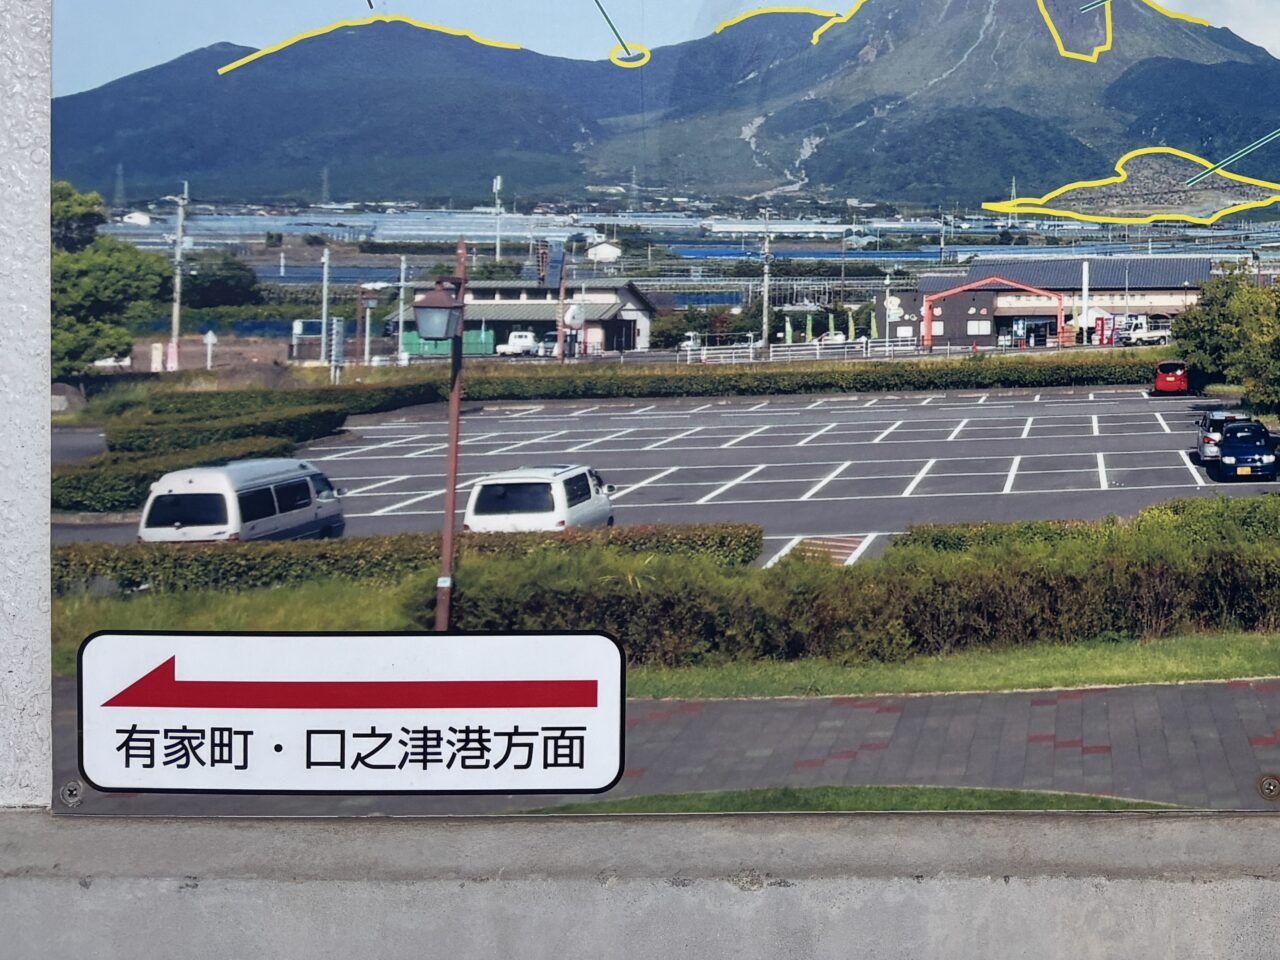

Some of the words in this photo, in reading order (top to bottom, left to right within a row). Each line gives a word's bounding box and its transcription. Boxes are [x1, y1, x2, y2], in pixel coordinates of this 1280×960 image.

[115, 723, 587, 771] 有家町・口之津港方面
